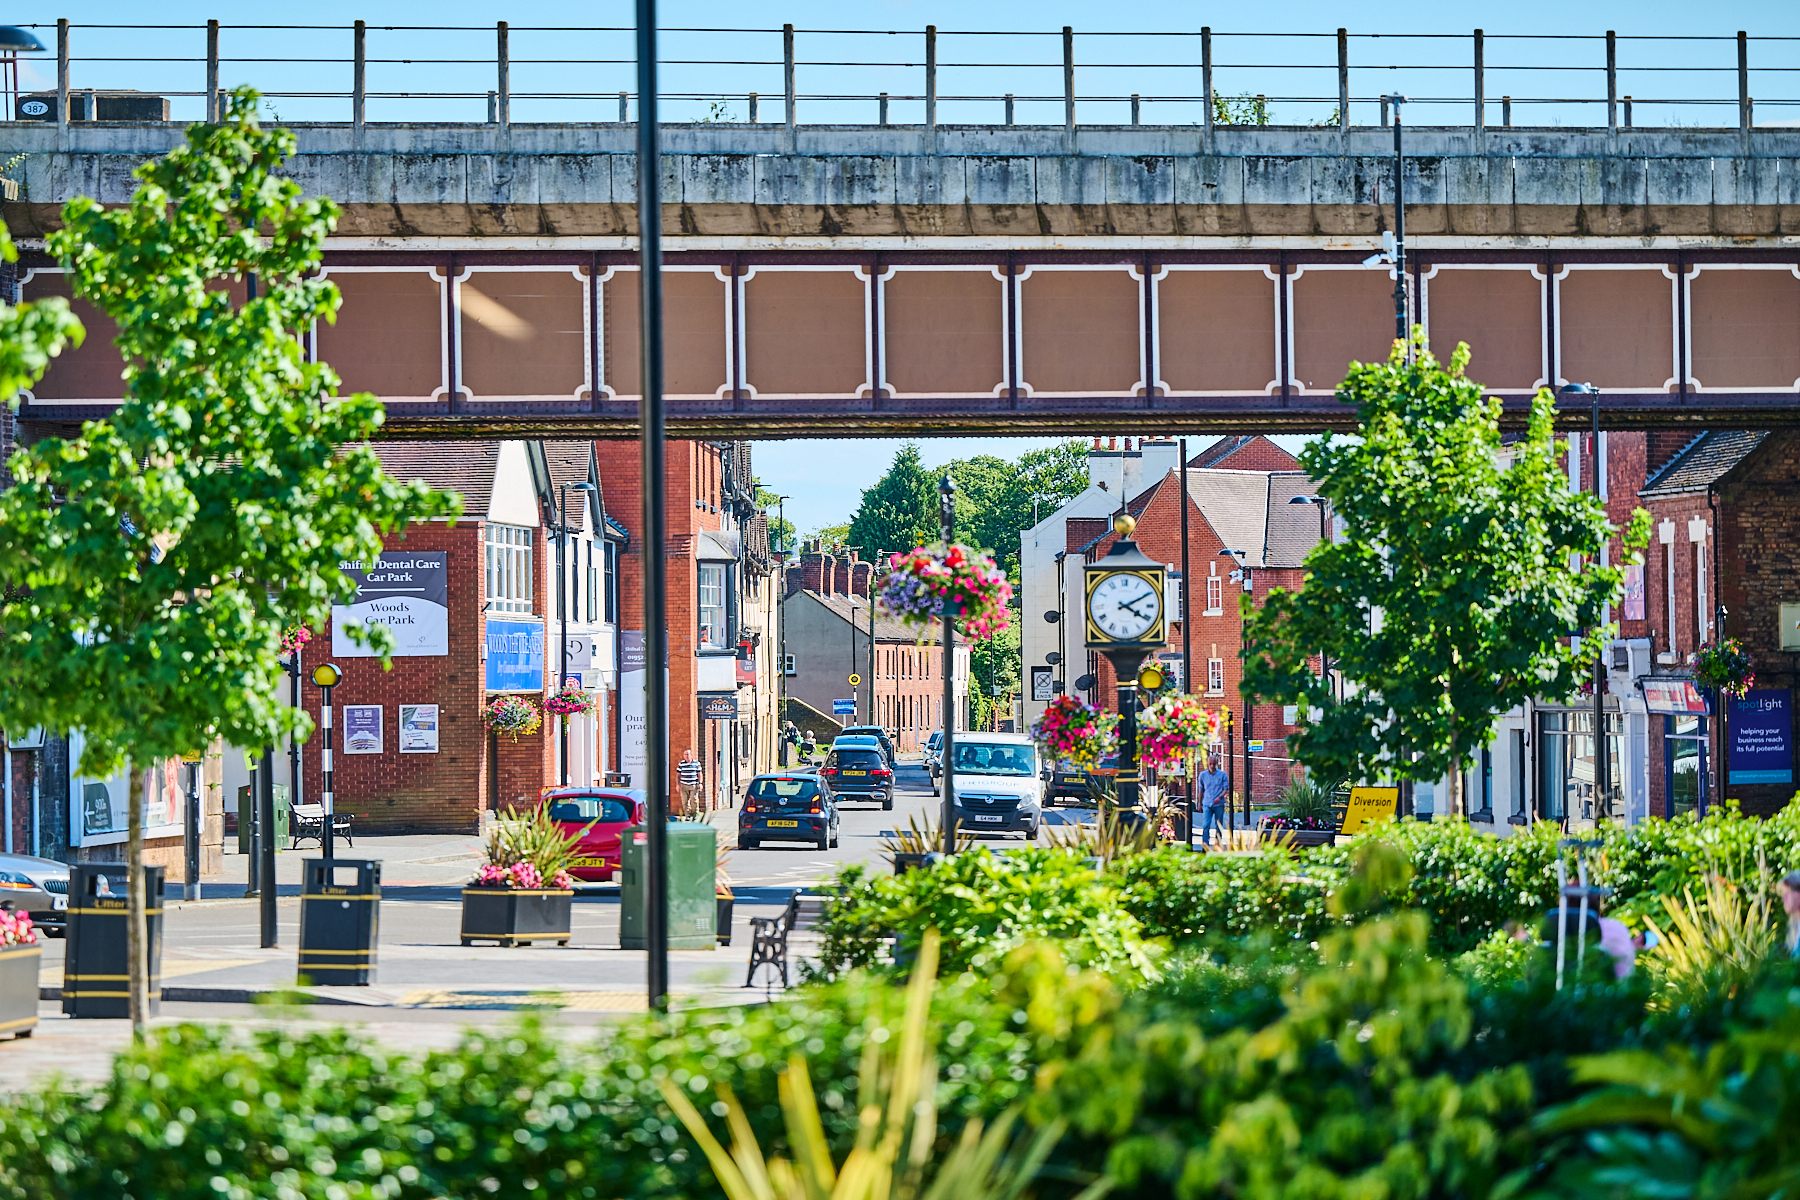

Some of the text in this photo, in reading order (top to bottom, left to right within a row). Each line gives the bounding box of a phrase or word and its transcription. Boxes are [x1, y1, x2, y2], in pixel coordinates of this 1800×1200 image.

[27, 105, 44, 113] 387
[338, 559, 440, 570] Shifnal Dental Care
[366, 571, 413, 582] Car Park
[370, 602, 410, 612] Woods
[365, 614, 415, 625] Car Park
[711, 704, 730, 712] H&M
[1737, 698, 1782, 711] spotlight
[625, 714, 645, 722] Our
[626, 724, 647, 733] prac
[1756, 744, 1785, 753] potential
[1354, 797, 1392, 806] Diversion
[320, 887, 347, 895] Litter
[94, 899, 125, 908] Litter
